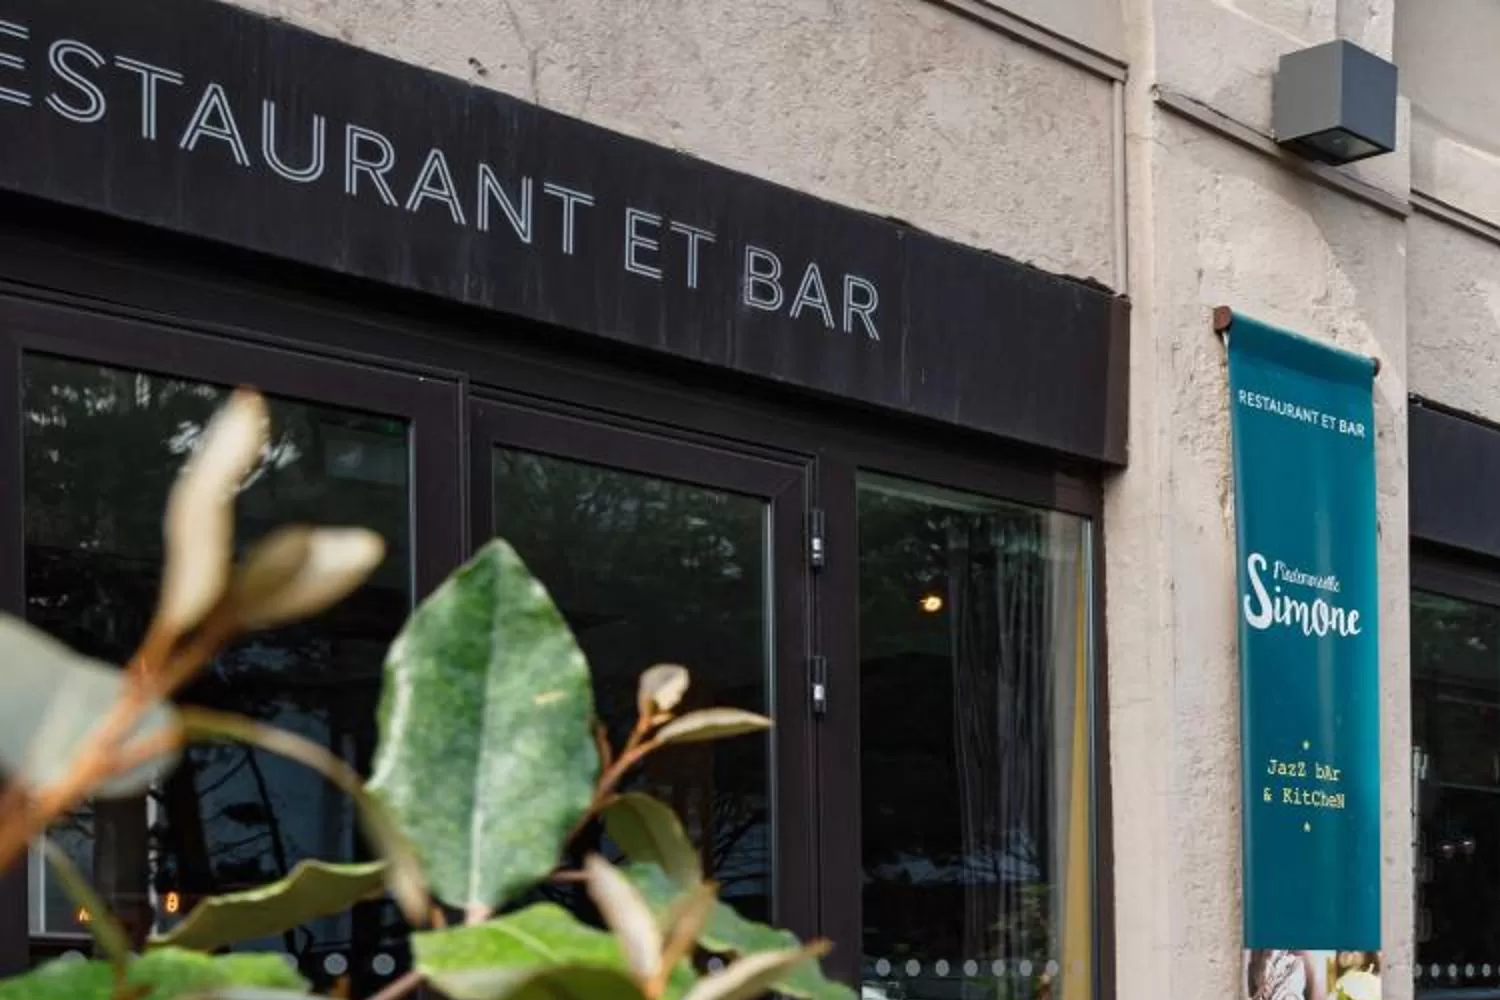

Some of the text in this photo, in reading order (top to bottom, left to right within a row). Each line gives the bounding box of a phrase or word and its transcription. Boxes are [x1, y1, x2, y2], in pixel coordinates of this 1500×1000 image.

[624, 207, 716, 290] ET
[743, 244, 881, 341] BAR
[1238, 389, 1366, 438] RESTAURANT ET BAR
[1243, 552, 1362, 637] Simone
[1263, 787, 1273, 802] &
